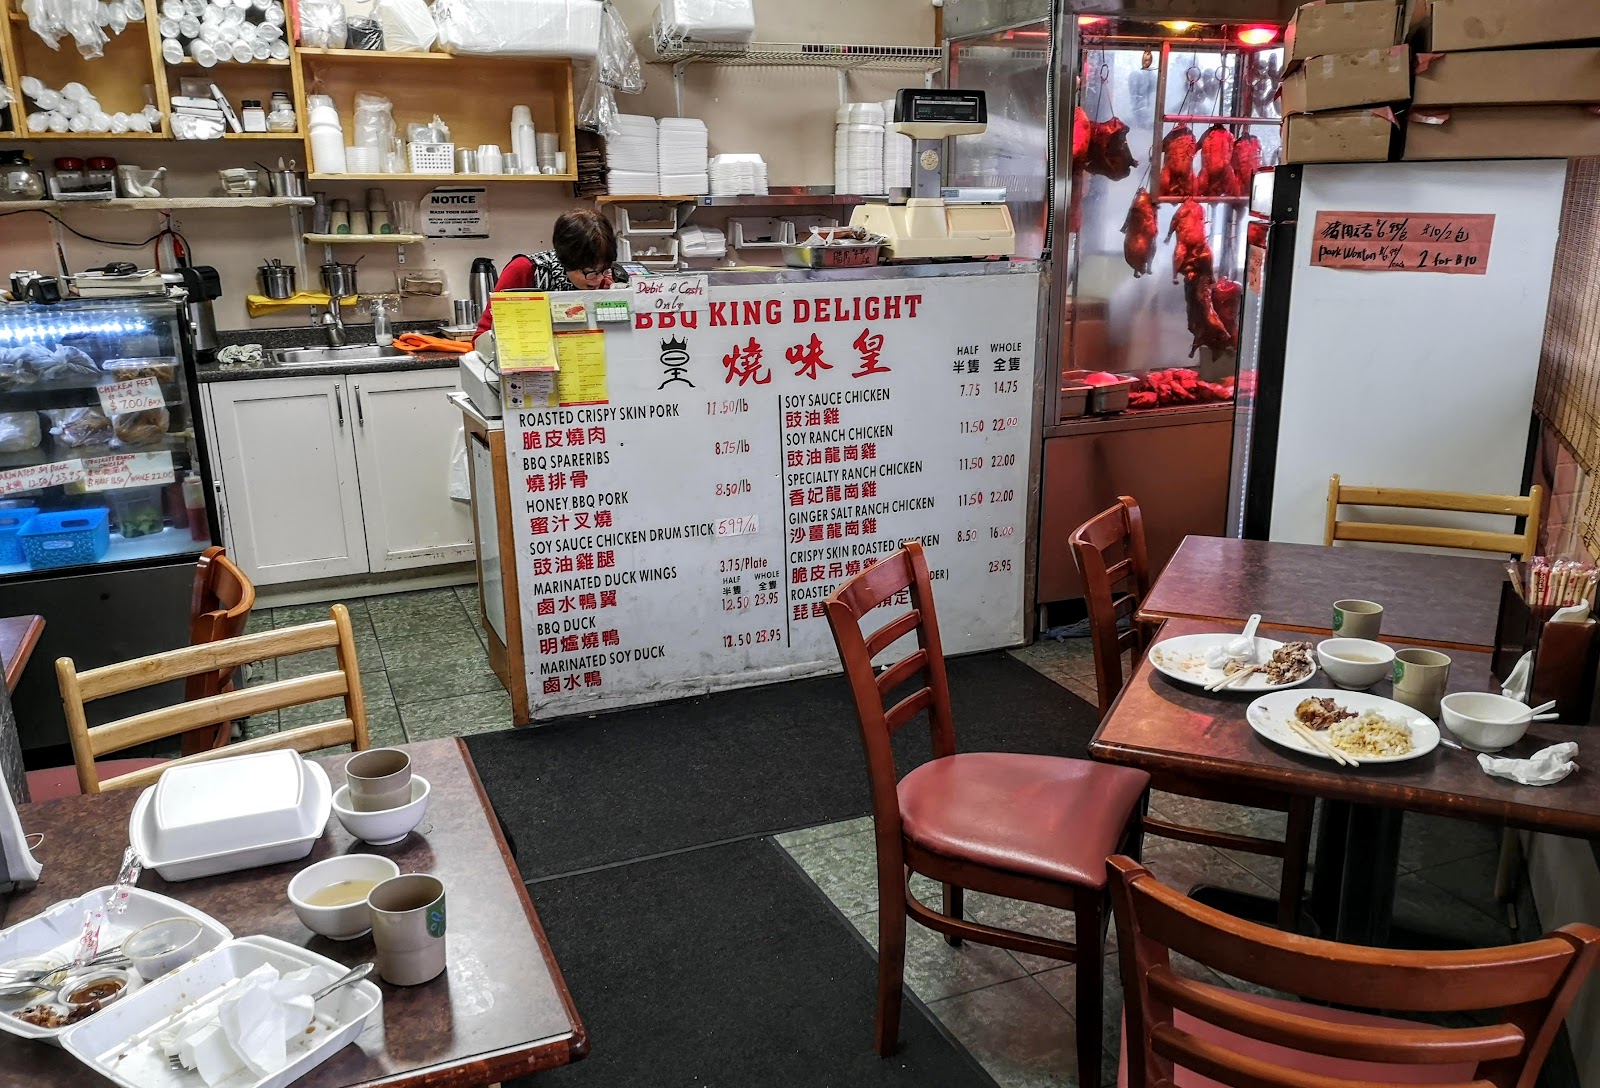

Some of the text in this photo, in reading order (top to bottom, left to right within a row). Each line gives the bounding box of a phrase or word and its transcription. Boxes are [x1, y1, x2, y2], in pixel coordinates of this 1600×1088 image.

[431, 195, 476, 204] NOTICE
[1417, 250, 1429, 269] 2
[1432, 252, 1453, 266] for
[635, 281, 665, 295] Debit
[678, 279, 703, 296] Cash
[635, 294, 922, 330] BBQ KING DELIGHT
[655, 295, 685, 311] Only
[722, 327, 892, 387] 燒味皇
[957, 345, 979, 356] HALF
[990, 342, 1022, 353] WHOLE
[953, 359, 980, 374] 半隻
[993, 357, 1021, 372] 全隻
[98, 377, 153, 394] CHICKEN FEET
[960, 380, 1018, 397] 7.75 14.75
[707, 398, 749, 415] 11.50/lb
[785, 388, 890, 409] SOY SAUCE CHICKEN
[519, 403, 680, 428] ROASTED CRISPY SKIN PORK
[786, 407, 840, 429] 豉油雞
[960, 417, 1018, 434] 11.50 22.00
[522, 426, 606, 450] 脆皮燒肉
[786, 425, 893, 447] SOY RANCH CHICKEN
[715, 439, 750, 455] 8.75/lb
[523, 450, 610, 471] BBQ SPARERIBS
[959, 454, 1015, 471] 11.50 22.00
[526, 469, 588, 493] 燒排骨
[788, 461, 923, 487] SPECIALTY RANCH CHICKEN
[716, 479, 751, 496] 8.50/lb
[526, 491, 629, 513] HONEY BBQ PORK
[959, 489, 1014, 507] 11.50 22.00
[789, 496, 935, 525] GINGER SALT RANCH CHICKEN
[530, 510, 613, 535] 蜜汁叉燒
[530, 522, 714, 556] SOY SAUCE CHICKEN DRUM STICK
[957, 526, 1014, 543] 8.50 16.00
[790, 534, 940, 564] CRISPY SKIN ROASTED CKEN
[533, 550, 615, 576] 豉油雞腿
[720, 556, 768, 573] 3.75/Plate
[989, 559, 1012, 573] 23.95
[534, 566, 677, 596] MARINATED DUCK WINGS
[722, 576, 741, 584] HALF
[754, 571, 779, 580] WHOLE
[722, 592, 778, 611] 12.50 23.95
[537, 616, 596, 636] BBQ DUCK
[540, 629, 620, 655] 明爐燒鴨
[723, 629, 781, 647] 12.50 23.95
[540, 645, 665, 675] MARINATED SOY DUCK
